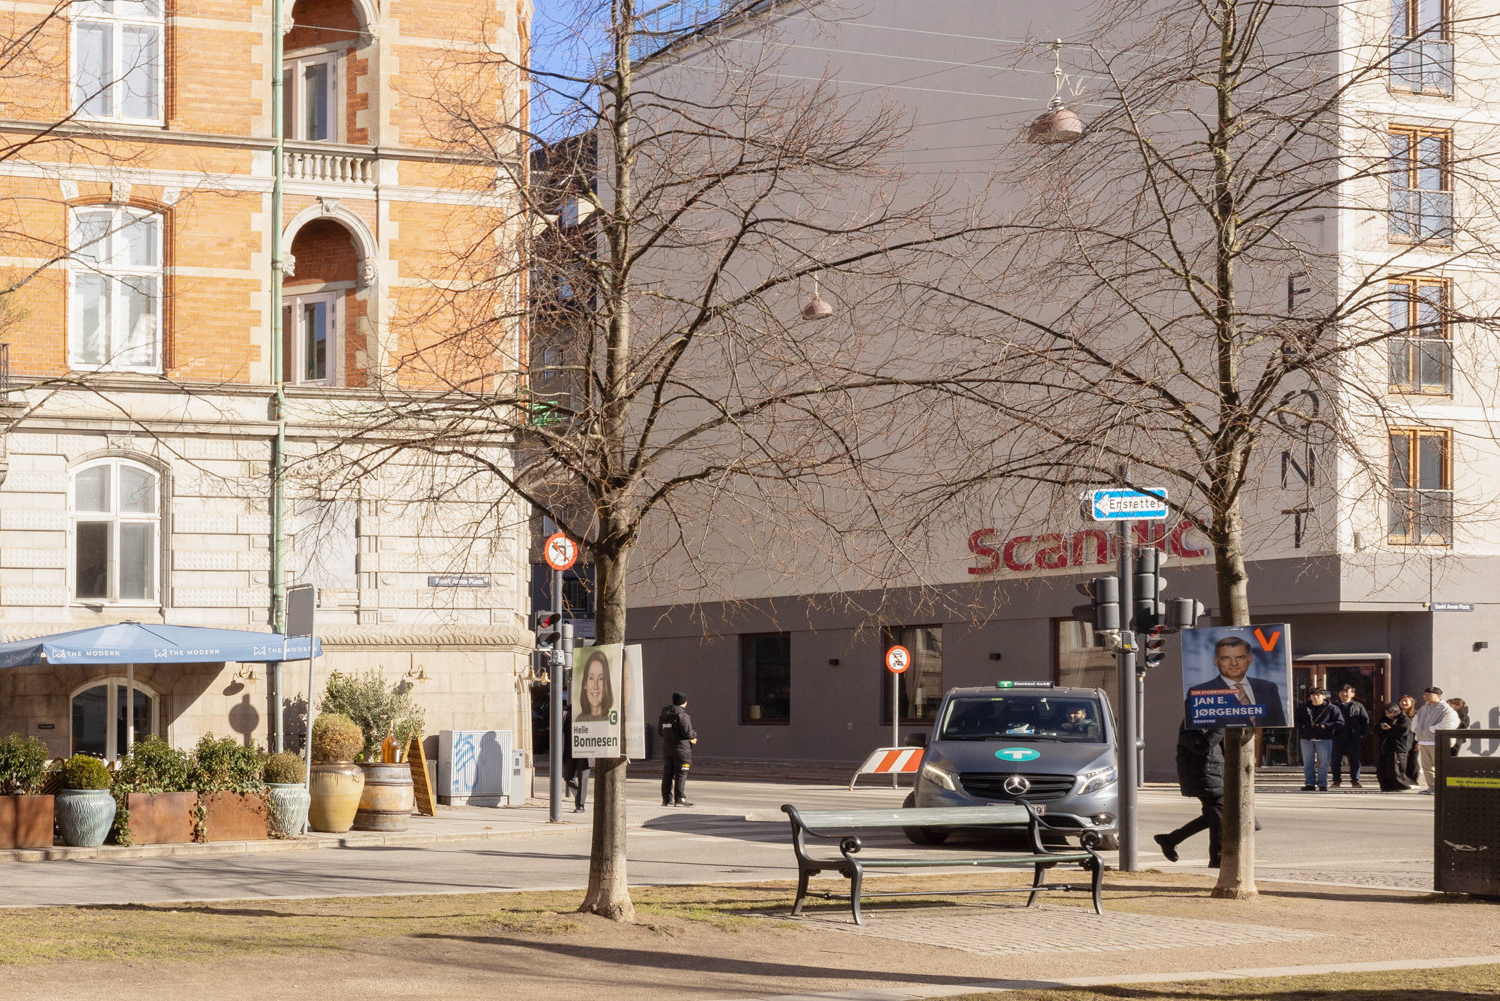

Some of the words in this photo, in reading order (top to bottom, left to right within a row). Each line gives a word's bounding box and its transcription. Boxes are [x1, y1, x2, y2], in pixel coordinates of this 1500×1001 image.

[1277, 270, 1320, 549] FONT
[1109, 499, 1161, 510] Ensrettet
[1253, 627, 1281, 652] V
[1194, 697, 1214, 707] JAN
[1217, 696, 1228, 705] E.
[1194, 707, 1263, 719] JØRGENSEN
[573, 725, 589, 734] Helle
[573, 735, 618, 748] Bonnesen
